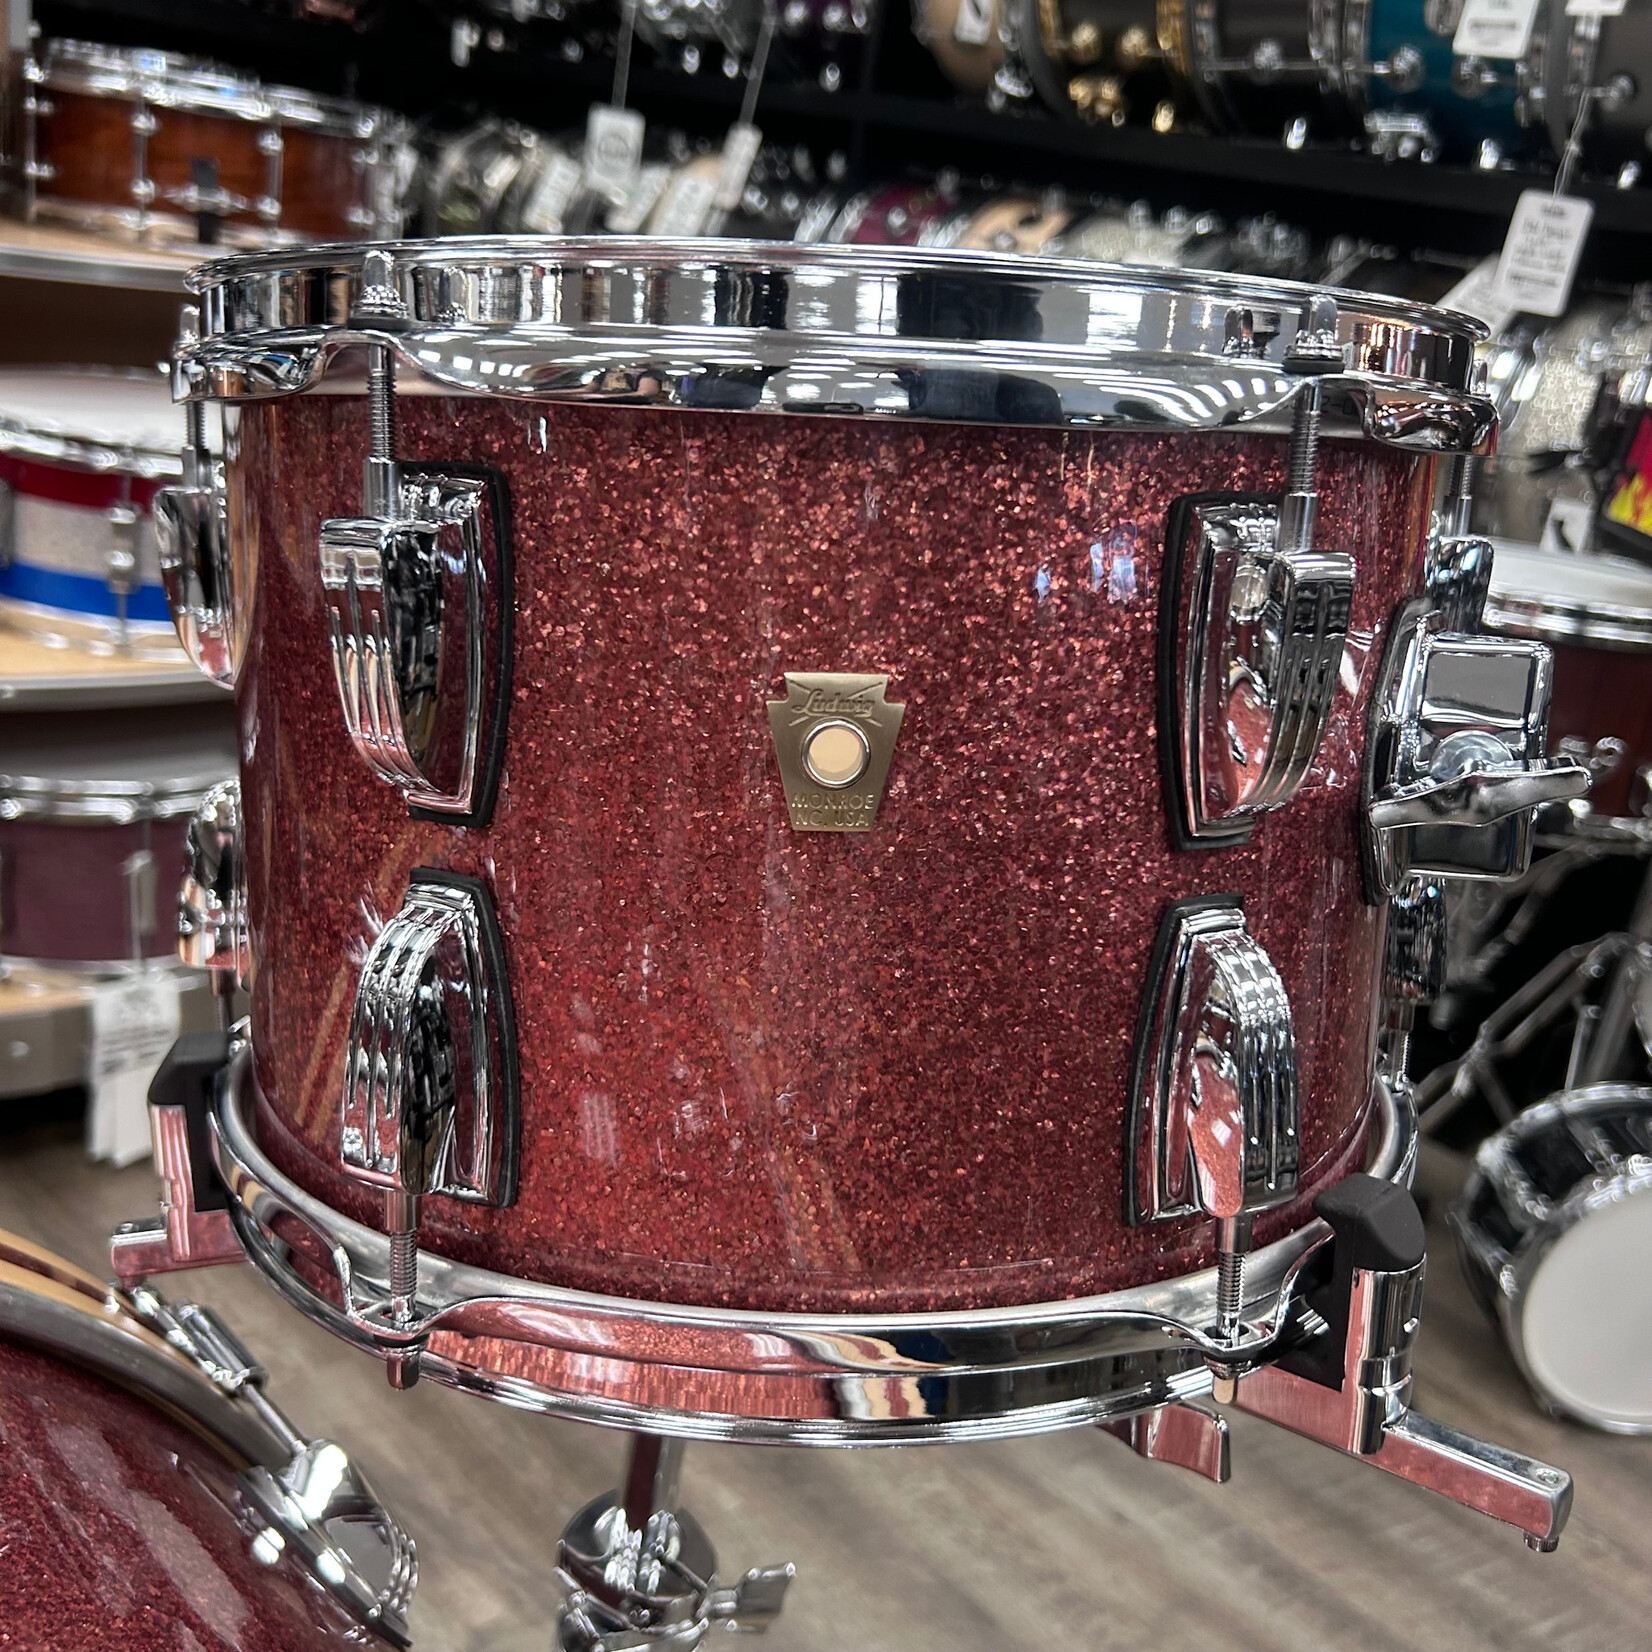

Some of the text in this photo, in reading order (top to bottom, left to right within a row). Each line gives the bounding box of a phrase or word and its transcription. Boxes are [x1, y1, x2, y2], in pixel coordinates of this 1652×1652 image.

[791, 689, 875, 718] Ludwig
[791, 794, 874, 810] MONROE
[833, 811, 869, 827] USA
